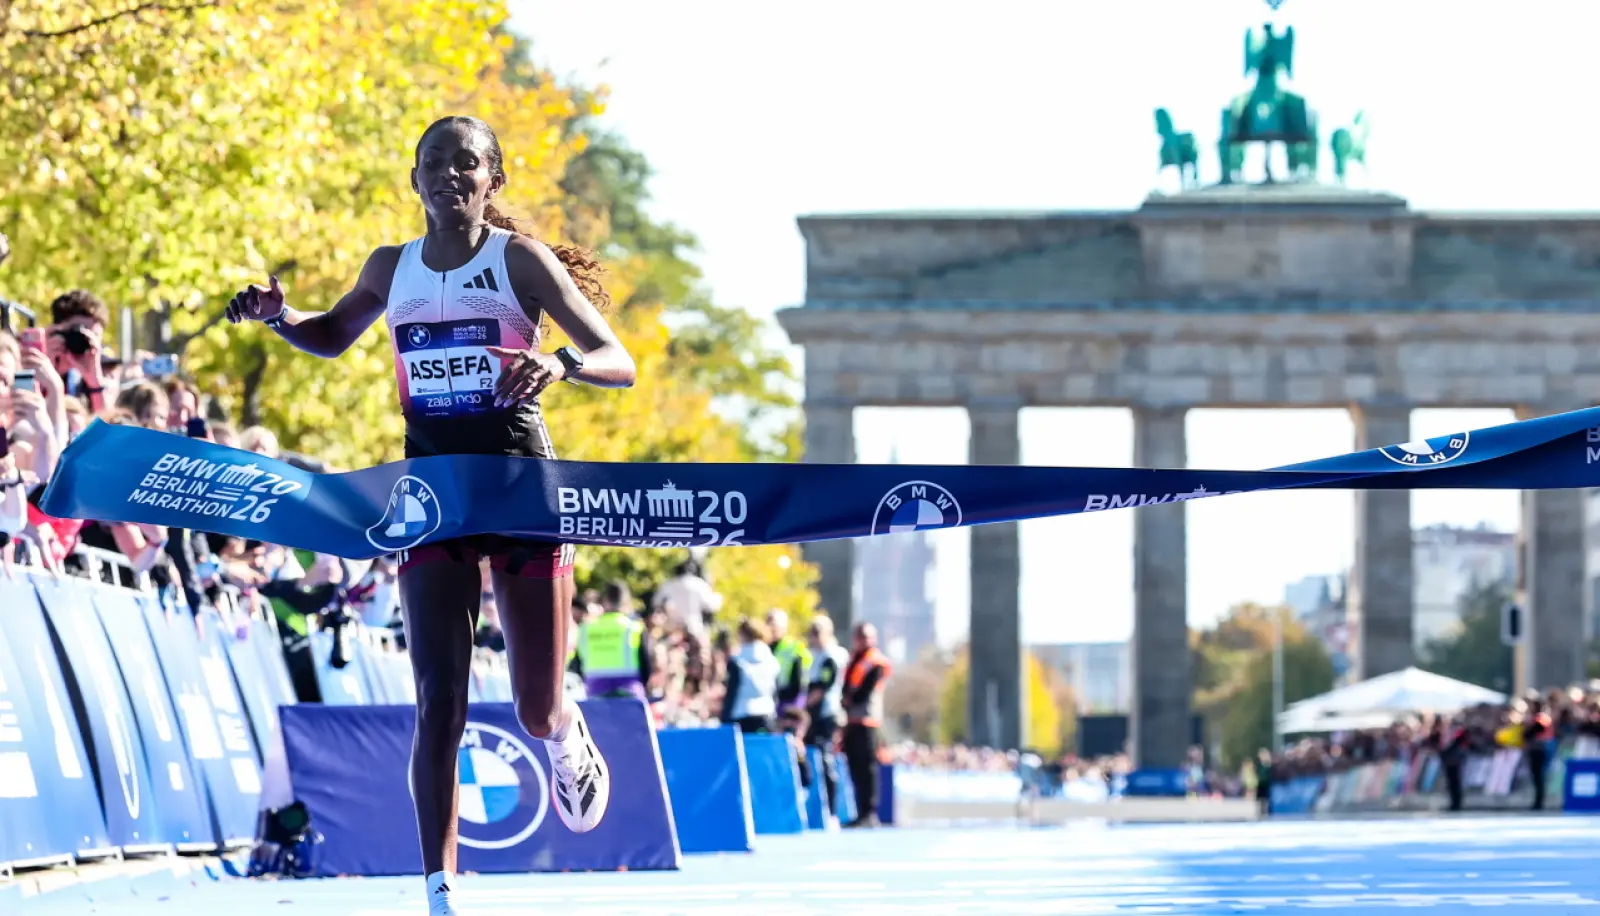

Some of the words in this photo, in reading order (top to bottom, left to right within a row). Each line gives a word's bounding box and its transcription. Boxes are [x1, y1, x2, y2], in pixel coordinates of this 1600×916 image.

[411, 355, 492, 380] ASSEFA
[480, 377, 493, 388] F2
[426, 393, 482, 407] zalando
[1401, 438, 1464, 463] BMW
[140, 472, 210, 496] BERLIN
[152, 453, 228, 480] BMW
[250, 472, 303, 495] 20
[127, 488, 234, 518] MARATHON
[229, 495, 279, 523] 26
[390, 480, 431, 508] BMW
[557, 487, 641, 515] BMW
[697, 490, 748, 525] 20
[886, 485, 952, 511] BMW
[559, 516, 644, 537] BERLIN
